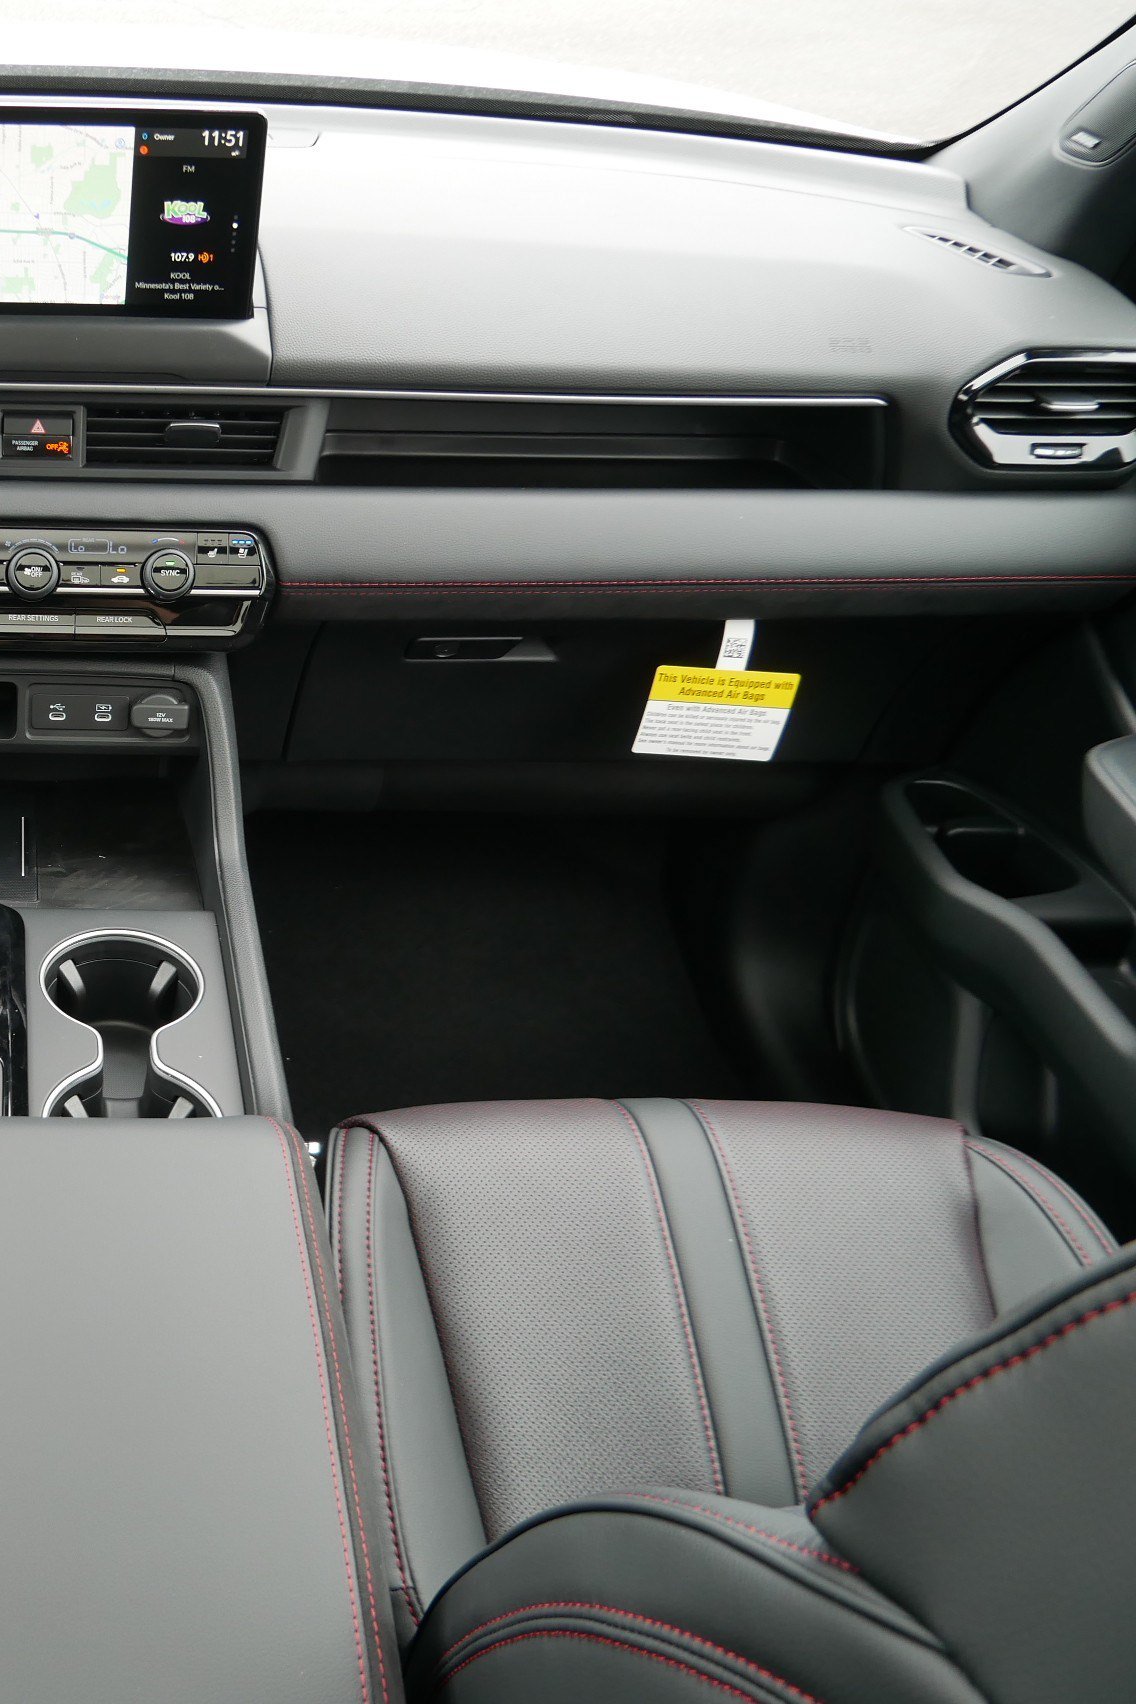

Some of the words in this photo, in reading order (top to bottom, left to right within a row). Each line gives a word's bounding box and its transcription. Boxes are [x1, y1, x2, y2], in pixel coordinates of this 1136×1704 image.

[202, 130, 244, 147] 11:51
[182, 165, 195, 173] FM
[170, 253, 195, 262] 107.9
[170, 272, 191, 280] KOOL
[135, 281, 173, 290] Minnesota's
[191, 283, 213, 292] Variety
[160, 569, 181, 577] SYNC
[27, 614, 59, 622] SETTINGS
[658, 672, 677, 683] This
[681, 674, 714, 685] Vehicle
[717, 677, 725, 686] is
[728, 678, 771, 690] Equipped
[774, 680, 794, 690] with
[678, 687, 723, 698] Advanced
[726, 689, 740, 699] Air
[743, 691, 766, 702] Bags
[702, 705, 735, 714] Advanced
